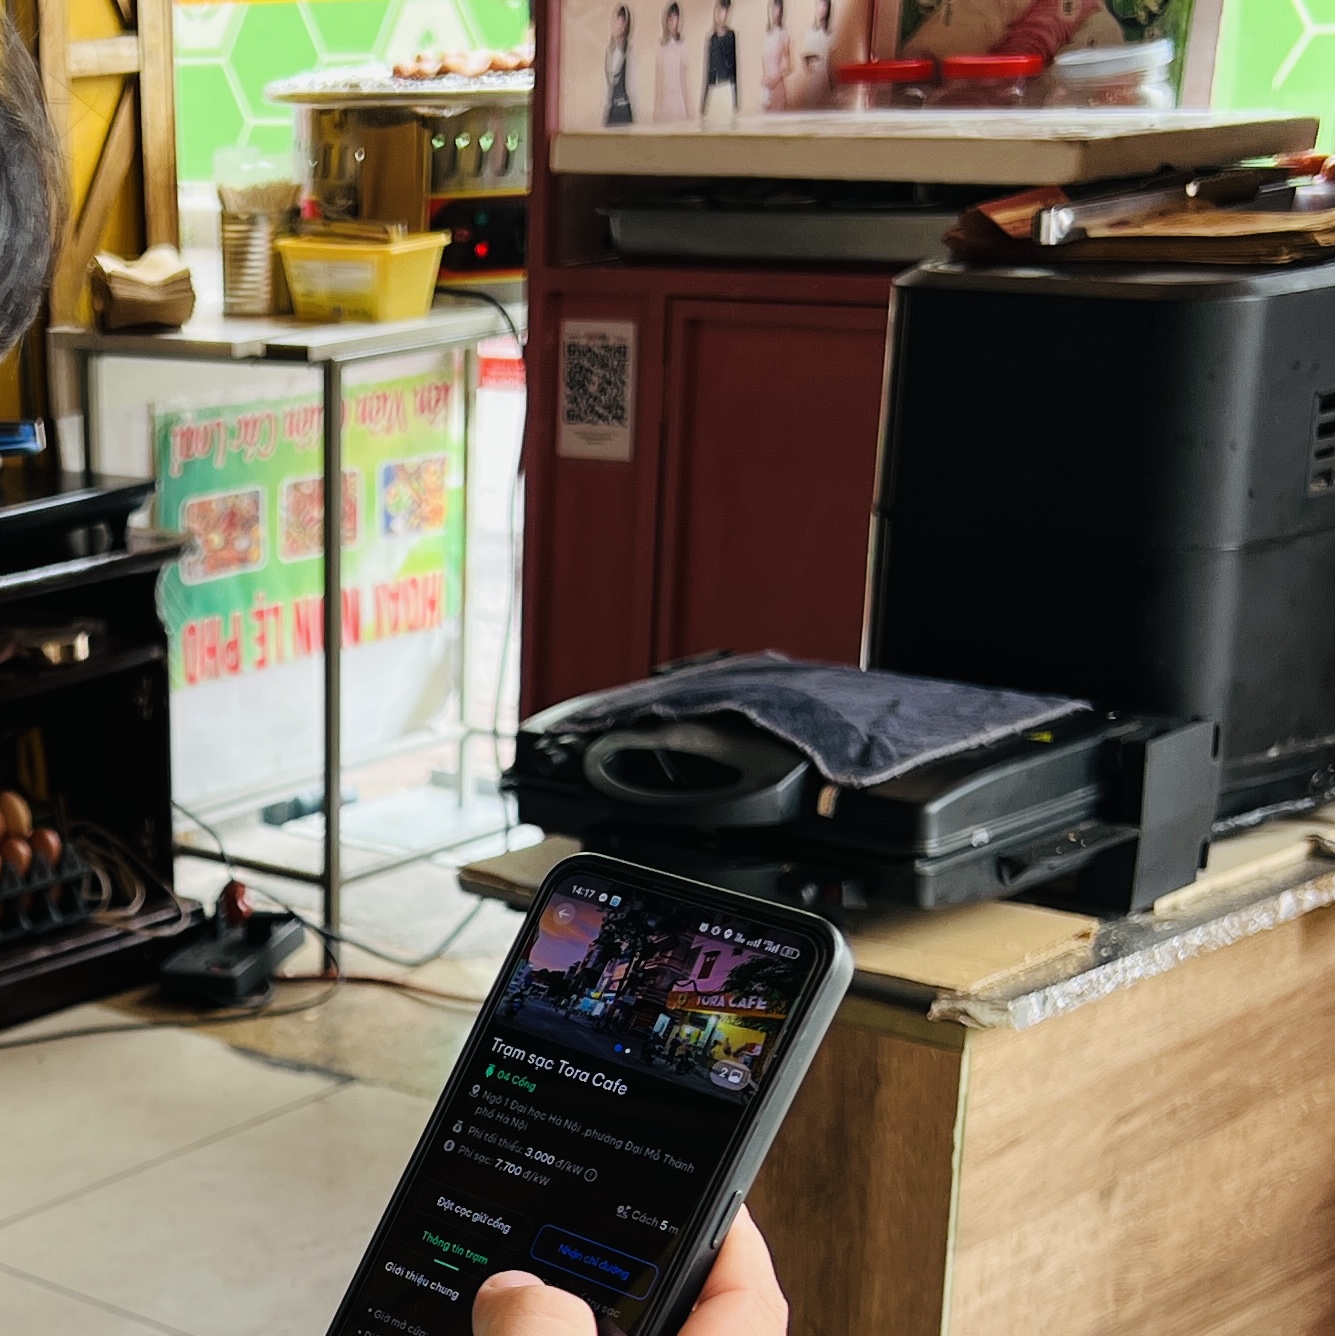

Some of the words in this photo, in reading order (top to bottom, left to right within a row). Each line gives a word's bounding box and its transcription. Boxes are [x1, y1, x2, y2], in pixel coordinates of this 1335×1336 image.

[572, 885, 596, 899] 14:17
[728, 996, 768, 1010] CAFE
[491, 1037, 526, 1061] Trạm
[527, 1053, 555, 1070] sạc
[558, 1059, 590, 1083] Tora
[591, 1072, 628, 1095] Cafe
[497, 1069, 511, 1081] 04
[511, 1075, 537, 1093] Cổng
[719, 1067, 729, 1078] 2
[474, 1106, 496, 1119] phố
[495, 1111, 510, 1124] Hà
[509, 1117, 528, 1131] Nội
[509, 1099, 527, 1114] Đại
[527, 1106, 547, 1121] học
[548, 1114, 563, 1126] Hà
[563, 1118, 581, 1133] Nội
[624, 1140, 643, 1155] Đại
[663, 1153, 695, 1173] Thành
[457, 1144, 475, 1158] Phí
[494, 1158, 523, 1176] 7,700
[522, 1170, 551, 1186] đ/kW
[467, 1125, 485, 1139] Phí
[524, 1147, 556, 1165] 3,000
[555, 1159, 584, 1175] đ/kW
[436, 1196, 455, 1211] Đặt
[454, 1205, 473, 1218] cọc
[471, 1212, 489, 1224] giữ
[486, 1216, 512, 1235] cổng
[631, 1210, 659, 1227] Cách
[659, 1220, 669, 1231] 5
[668, 1225, 679, 1235] m
[422, 1230, 451, 1252] Thông
[451, 1243, 465, 1256] tin
[465, 1249, 488, 1265] trạm
[558, 1243, 583, 1261] Nhận
[598, 1260, 630, 1281] đường
[385, 1261, 404, 1276] Giới
[404, 1270, 430, 1287] thiệu
[429, 1281, 460, 1301] chung
